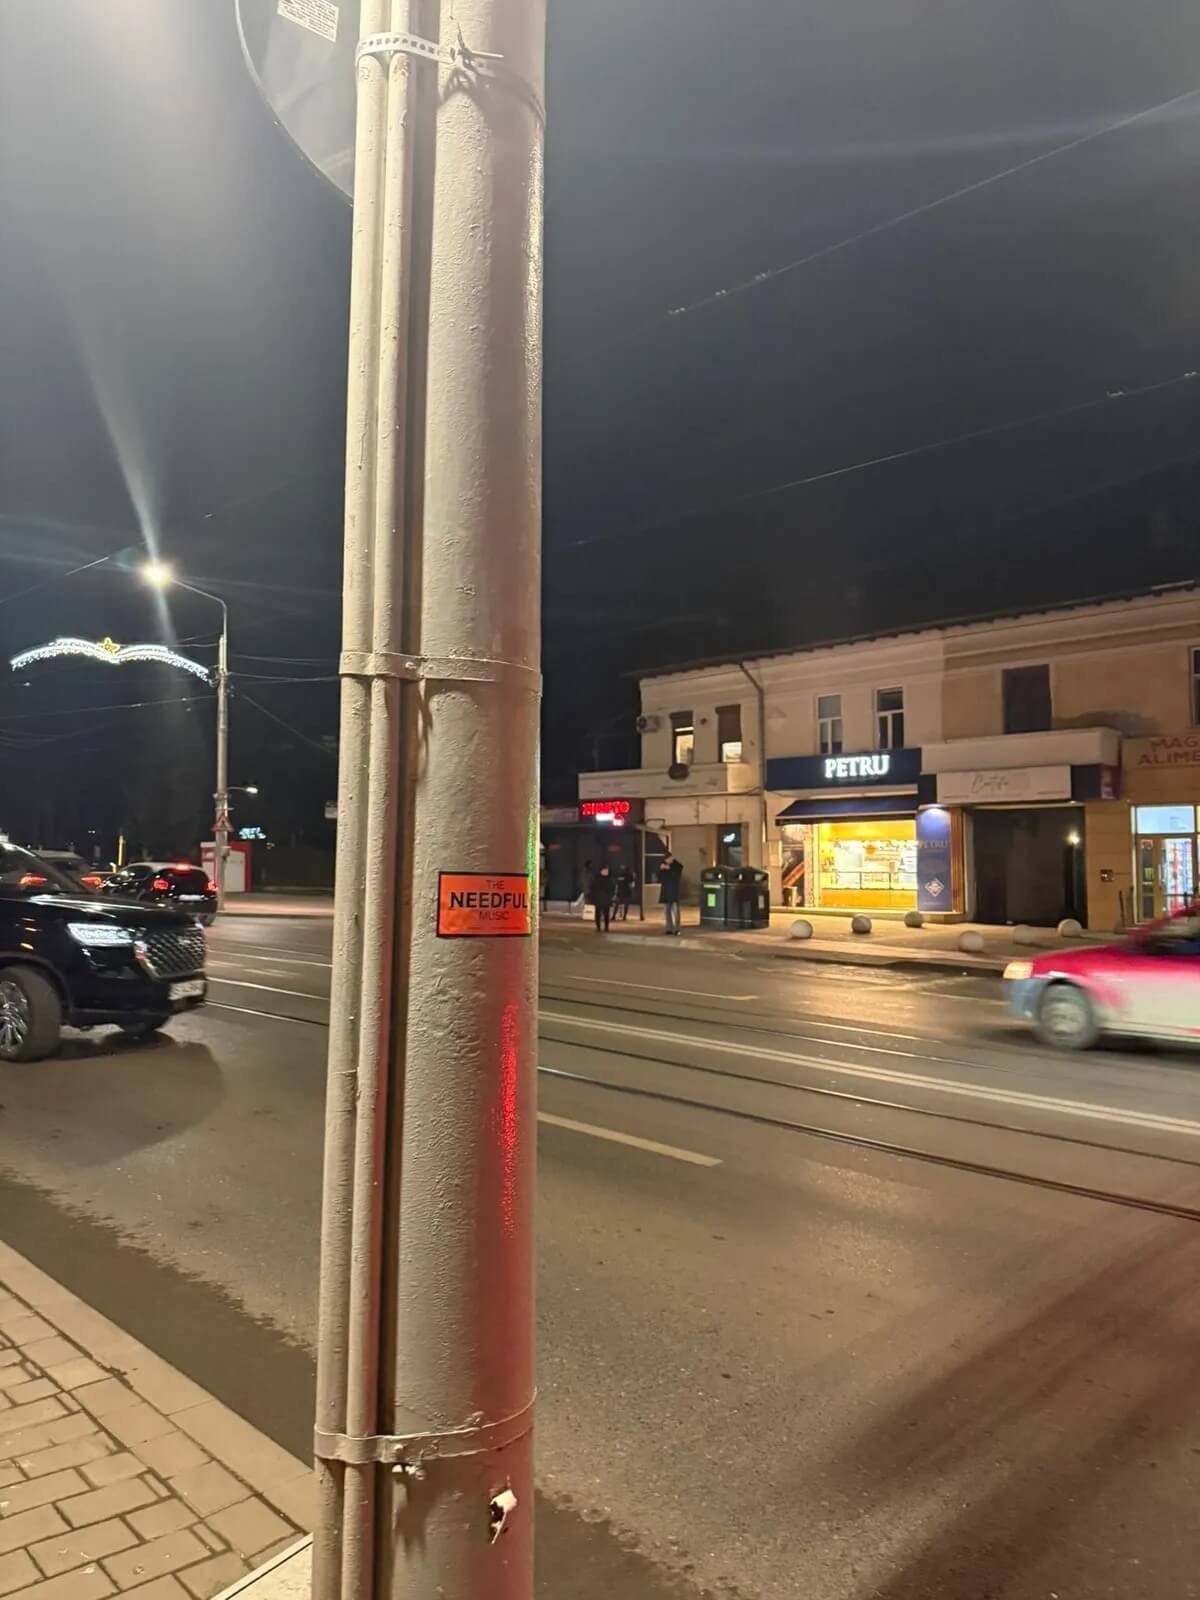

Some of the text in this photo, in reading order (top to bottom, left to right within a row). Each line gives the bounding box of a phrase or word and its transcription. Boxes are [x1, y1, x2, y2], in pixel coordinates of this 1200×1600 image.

[823, 754, 890, 779] PETRU
[486, 880, 504, 890] THE
[449, 892, 528, 909] NEEDFUL
